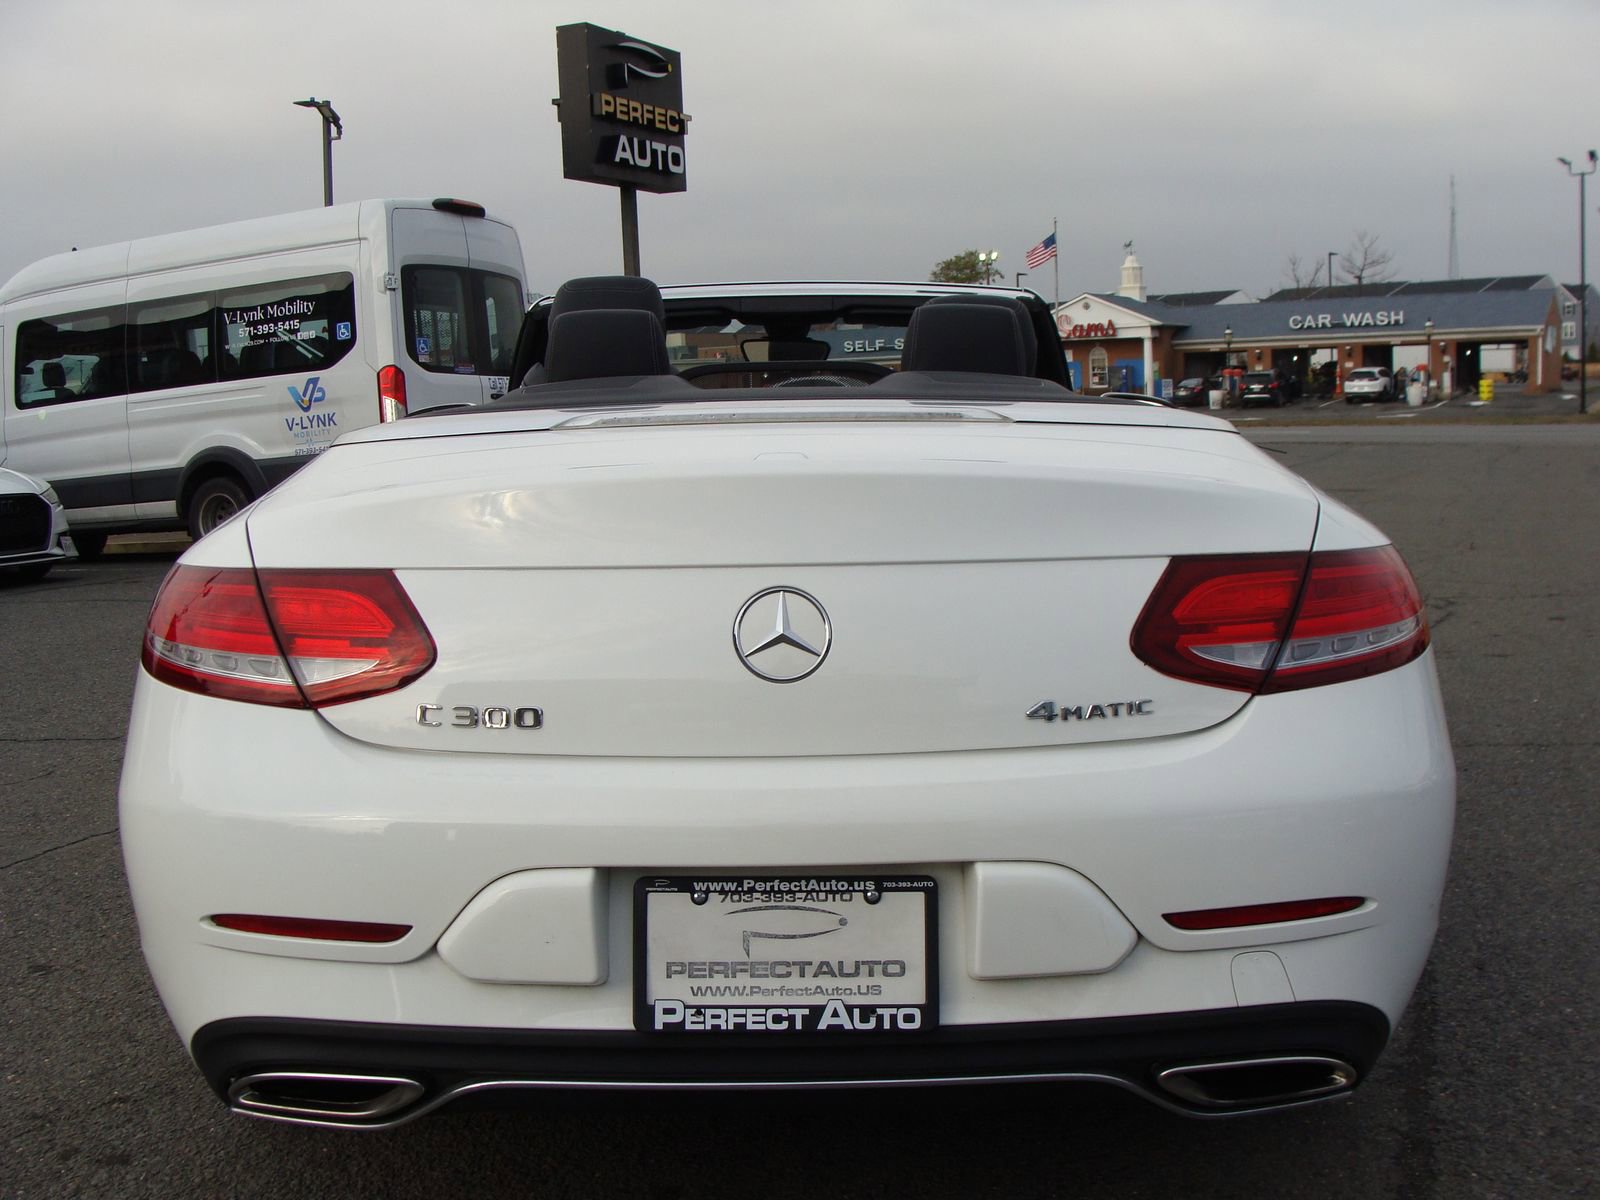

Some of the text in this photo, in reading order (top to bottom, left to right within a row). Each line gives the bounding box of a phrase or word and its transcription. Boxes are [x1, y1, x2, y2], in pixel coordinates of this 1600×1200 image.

[601, 92, 692, 135] PERFECT
[614, 134, 685, 174] AUTO
[224, 300, 316, 325] V-Lynk Mobility
[1289, 310, 1404, 329] CAR WASH
[239, 319, 300, 338] 571-393-5415
[844, 340, 885, 352] SELF
[285, 412, 338, 432] V-LYNK
[294, 428, 331, 439] MOBILITY
[416, 703, 543, 729] C 300
[1025, 699, 1154, 721] 4MATIC
[693, 879, 876, 891] www.PerfectAuto.us
[718, 892, 853, 903] 703-393-AUTO
[665, 960, 906, 979] PERFECTAUTO
[690, 985, 882, 998] WWW.PerfectAuto.US
[654, 999, 922, 1030] PERFECT AUTO
